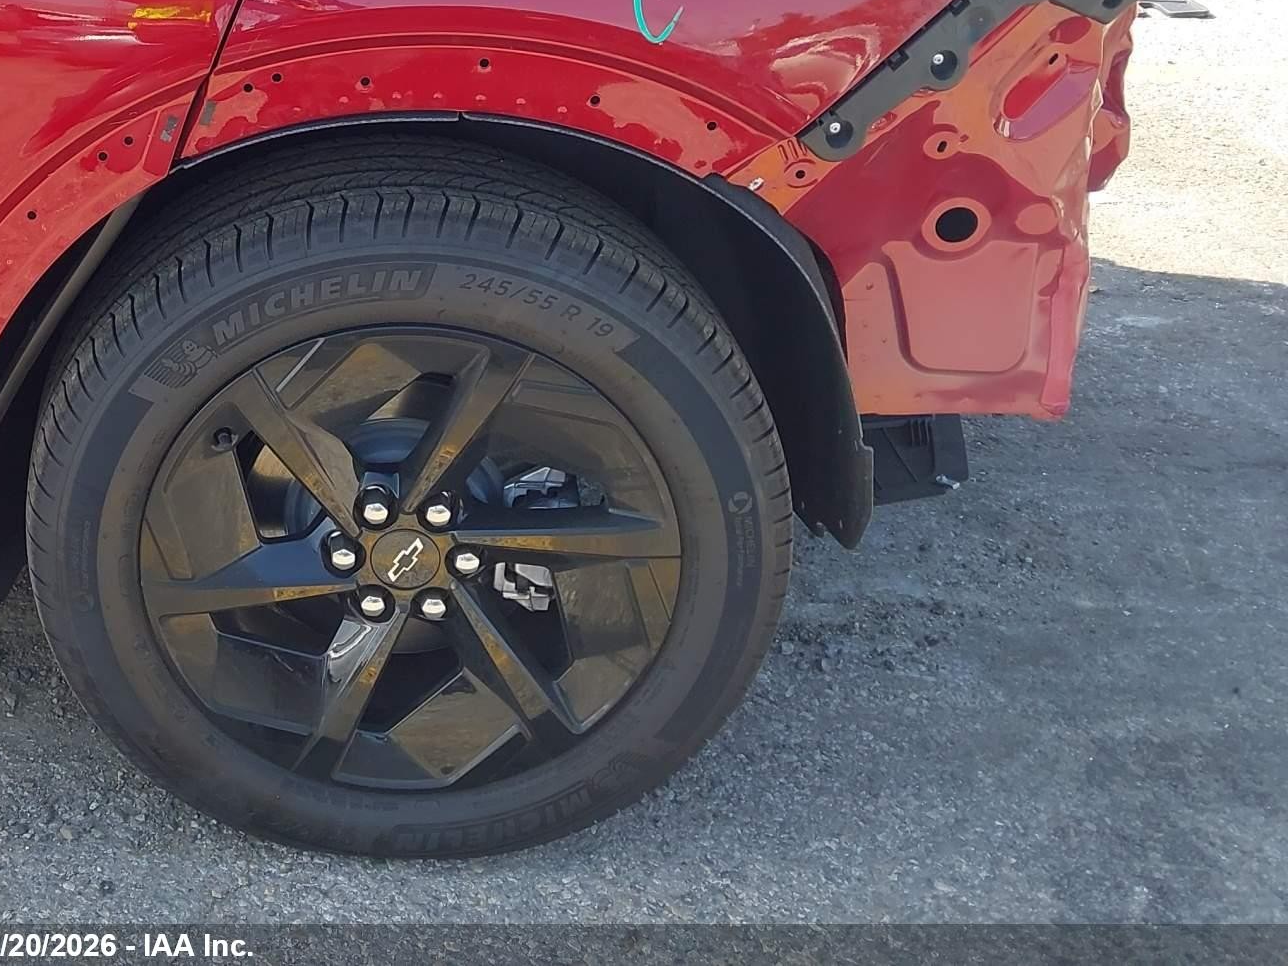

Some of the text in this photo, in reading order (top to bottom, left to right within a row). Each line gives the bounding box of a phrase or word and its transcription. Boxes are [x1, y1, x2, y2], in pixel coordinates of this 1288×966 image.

[213, 269, 423, 347] MICHELIN
[458, 273, 615, 338] 245/55 R 19
